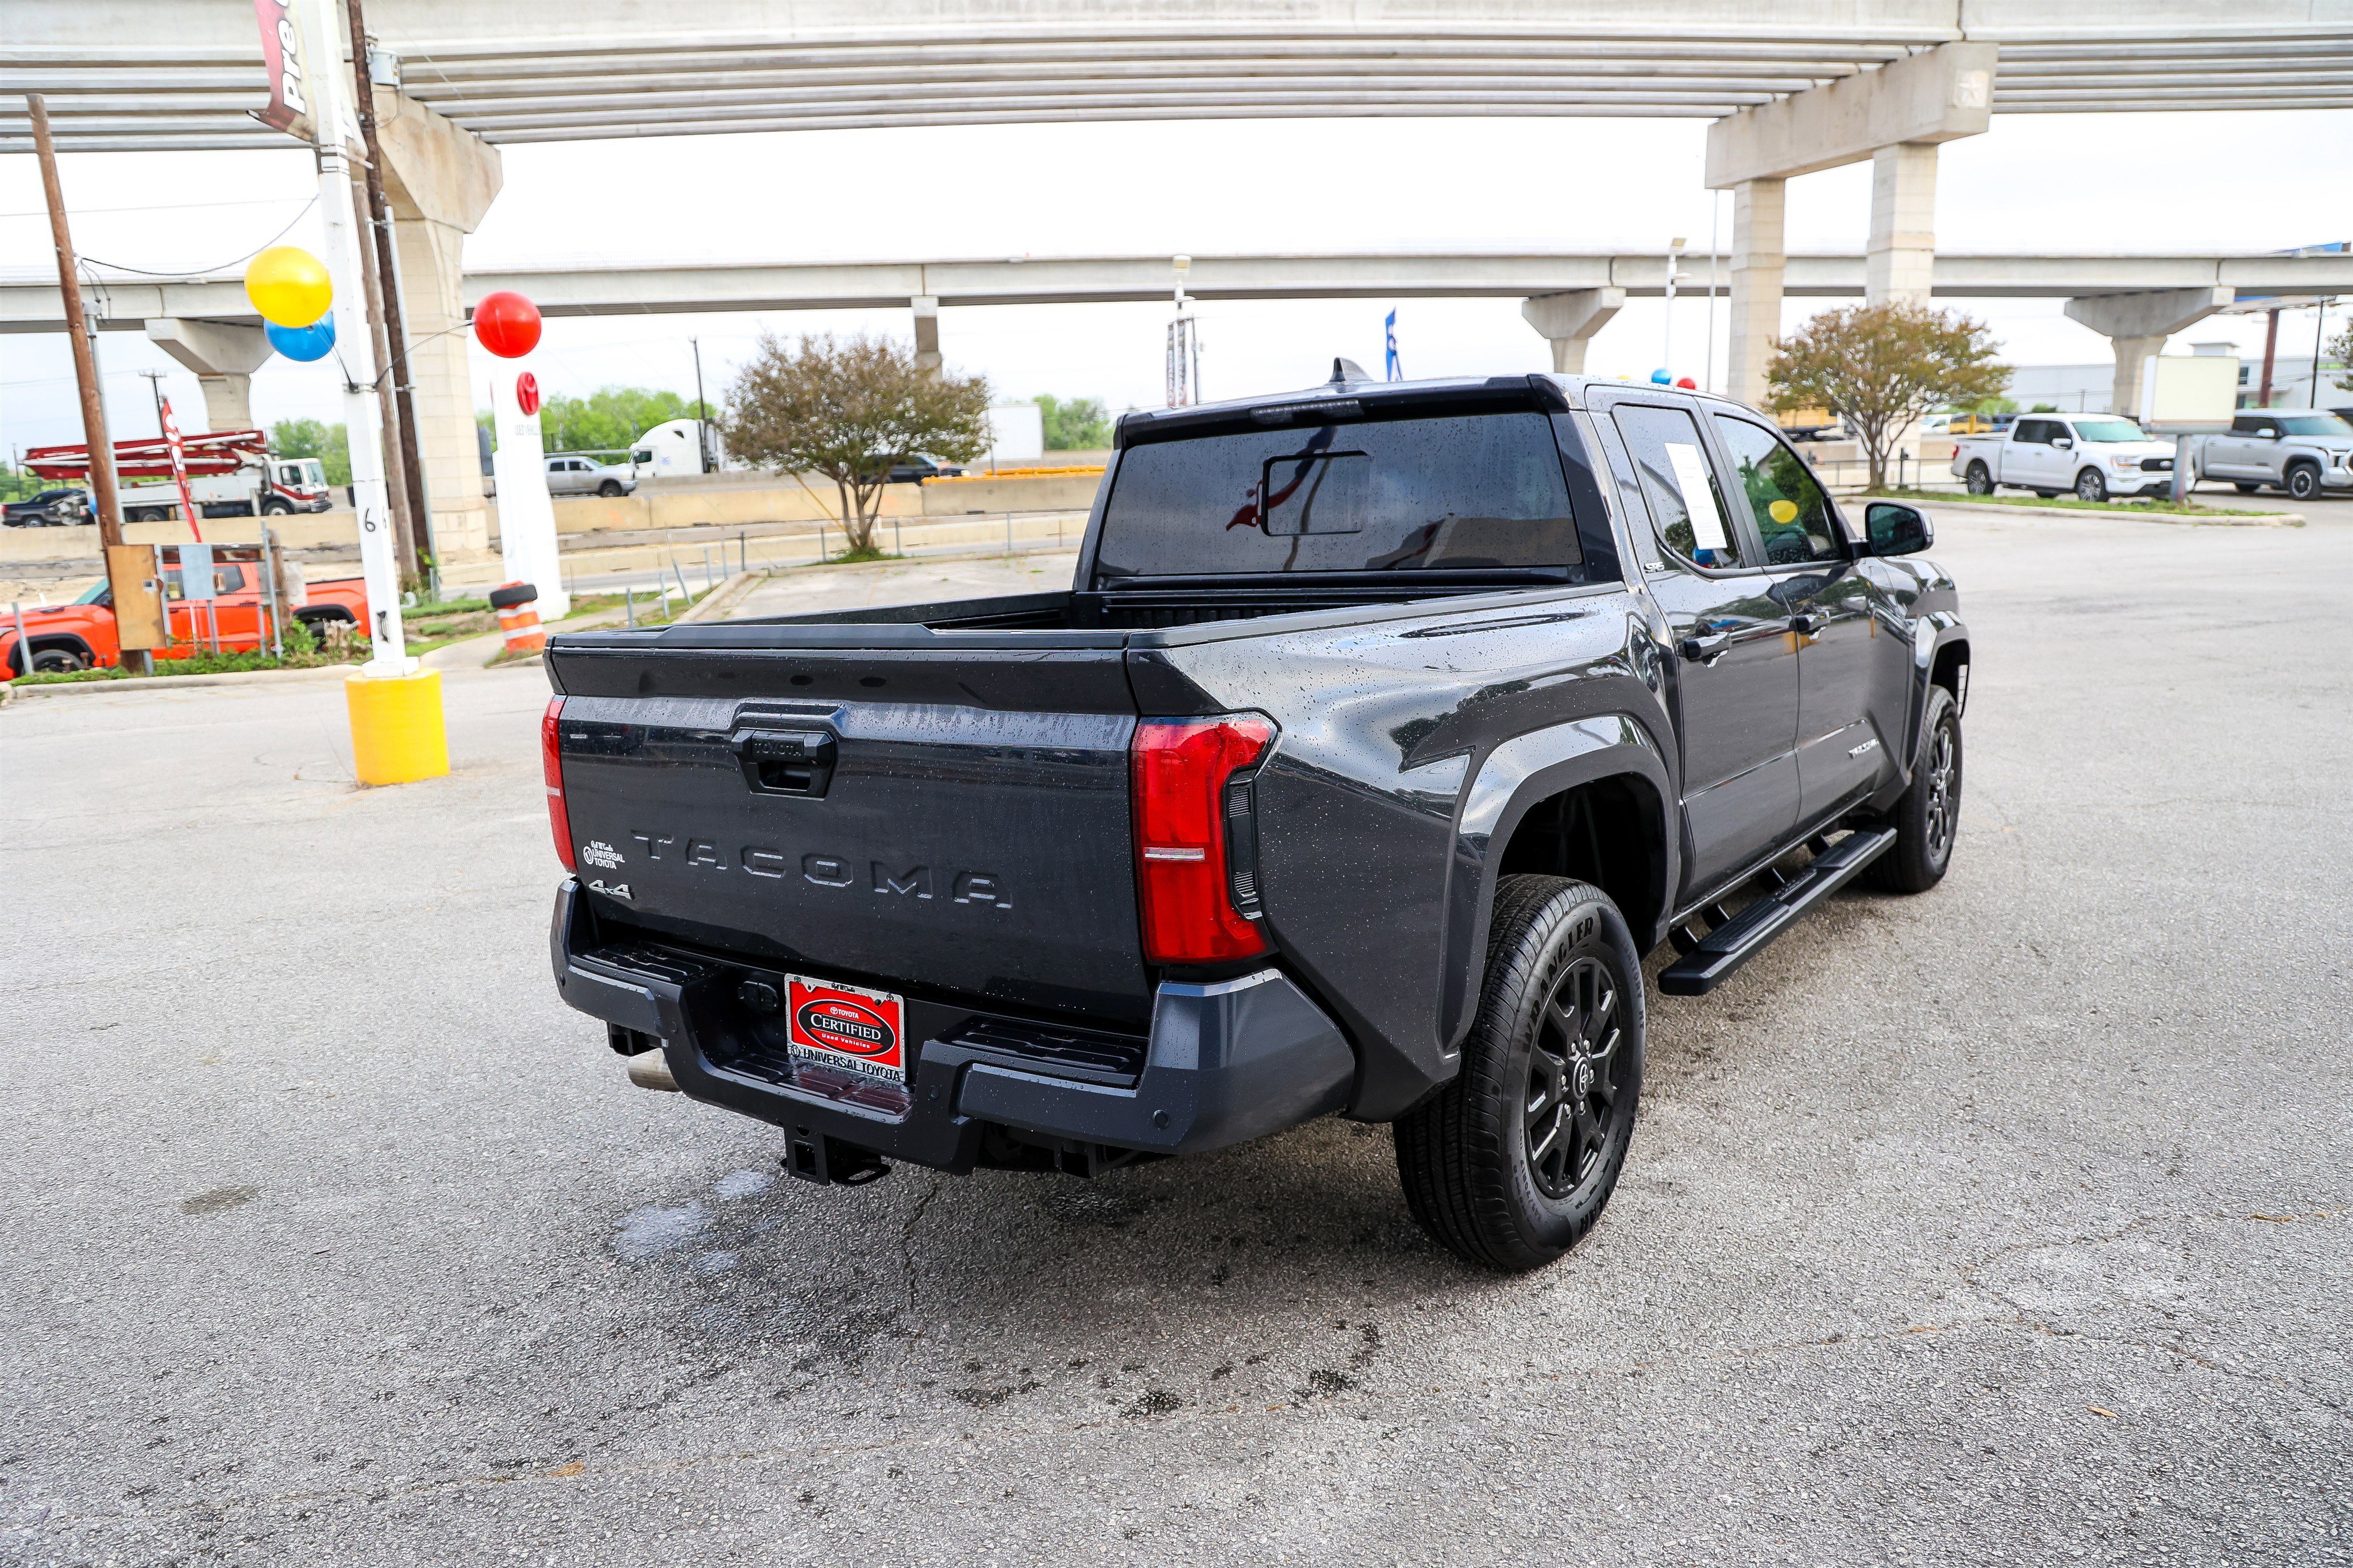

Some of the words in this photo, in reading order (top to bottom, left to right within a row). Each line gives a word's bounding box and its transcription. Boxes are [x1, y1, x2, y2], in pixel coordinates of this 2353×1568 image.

[363, 507, 376, 532] 6
[754, 739, 801, 756] TOYOTA
[592, 848, 625, 863] UNIVERSAL
[594, 857, 616, 870] TOYOTA
[631, 831, 1012, 909] TACOMA
[1521, 916, 1594, 1053] WRANGLER
[838, 1009, 859, 1019] TOYOTA
[810, 1013, 881, 1040] CERTIFIED
[821, 1033, 839, 1041] Used
[840, 1037, 870, 1049] Vehicles
[804, 1048, 860, 1072] UNIVERSAL
[862, 1062, 901, 1082] TOYOTA
